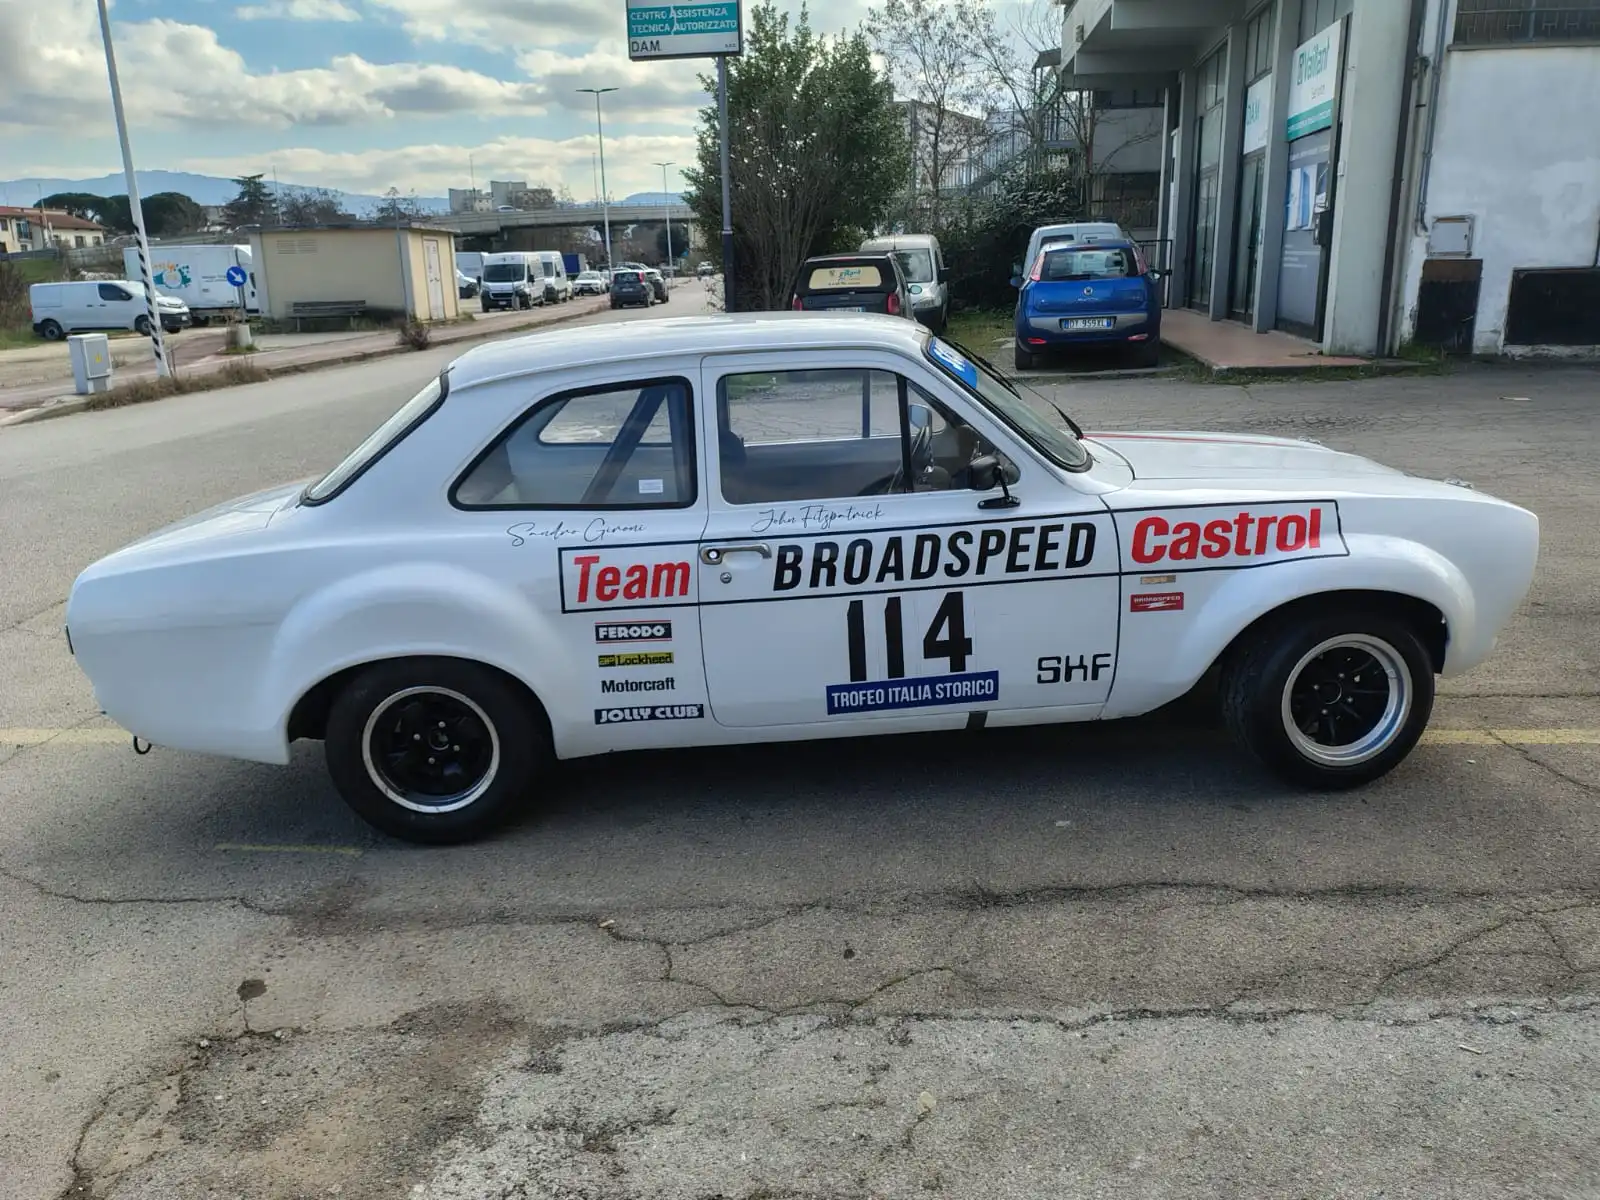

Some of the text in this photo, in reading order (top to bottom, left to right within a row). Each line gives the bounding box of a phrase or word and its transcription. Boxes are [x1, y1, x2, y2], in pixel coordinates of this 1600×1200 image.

[630, 7, 728, 21] CENTRO ASSISTENZA
[631, 20, 737, 33] TECNICA AUTORIZZATO
[751, 504, 886, 533] John Fitzpatrick
[506, 522, 580, 547] Sandro
[1131, 508, 1321, 564] Castrol
[573, 522, 1097, 603] Team BROADSPEED
[598, 625, 666, 639] FERODO
[847, 591, 973, 683] 114
[616, 653, 673, 666] Lockheed
[1036, 653, 1112, 684] SKF
[601, 677, 676, 693] Motorcraft
[831, 678, 995, 708] TROFEO ITALIA STORICO
[600, 706, 700, 723] JOLLY CLUB
